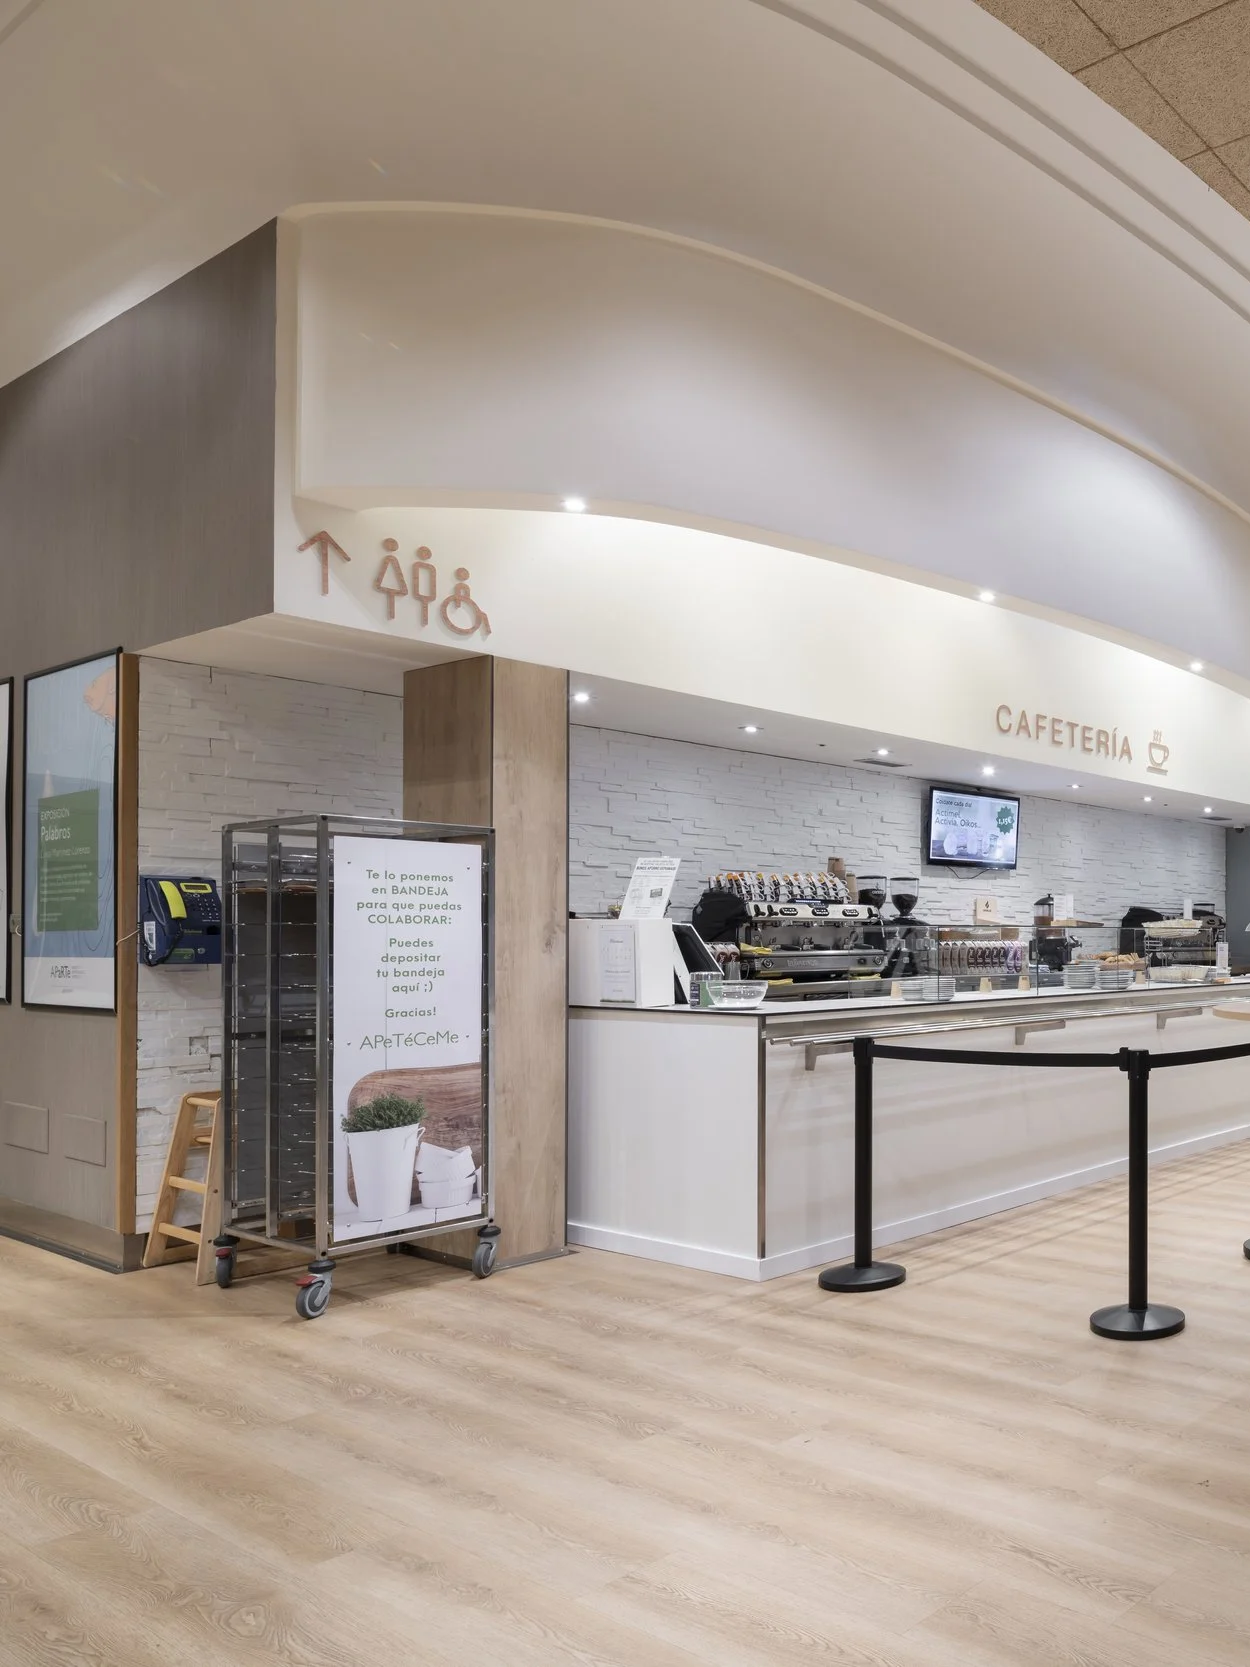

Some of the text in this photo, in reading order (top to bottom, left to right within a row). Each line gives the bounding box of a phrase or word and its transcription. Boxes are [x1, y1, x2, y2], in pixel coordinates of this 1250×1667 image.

[996, 704, 1133, 762] CAFETERÍA
[40, 826, 71, 841] Palabros
[366, 869, 454, 883] Te lo ponemos
[371, 885, 449, 896] en BANDEJA
[356, 901, 462, 912] para que puedas
[367, 914, 452, 925] COLABORAR:
[389, 938, 434, 948] Puedes
[380, 953, 442, 965] depositar
[376, 967, 445, 979] tu bandeja
[391, 980, 434, 994] aquí ;)
[384, 1006, 437, 1018] Gracias!
[359, 1030, 459, 1050] APeTéCeMe
